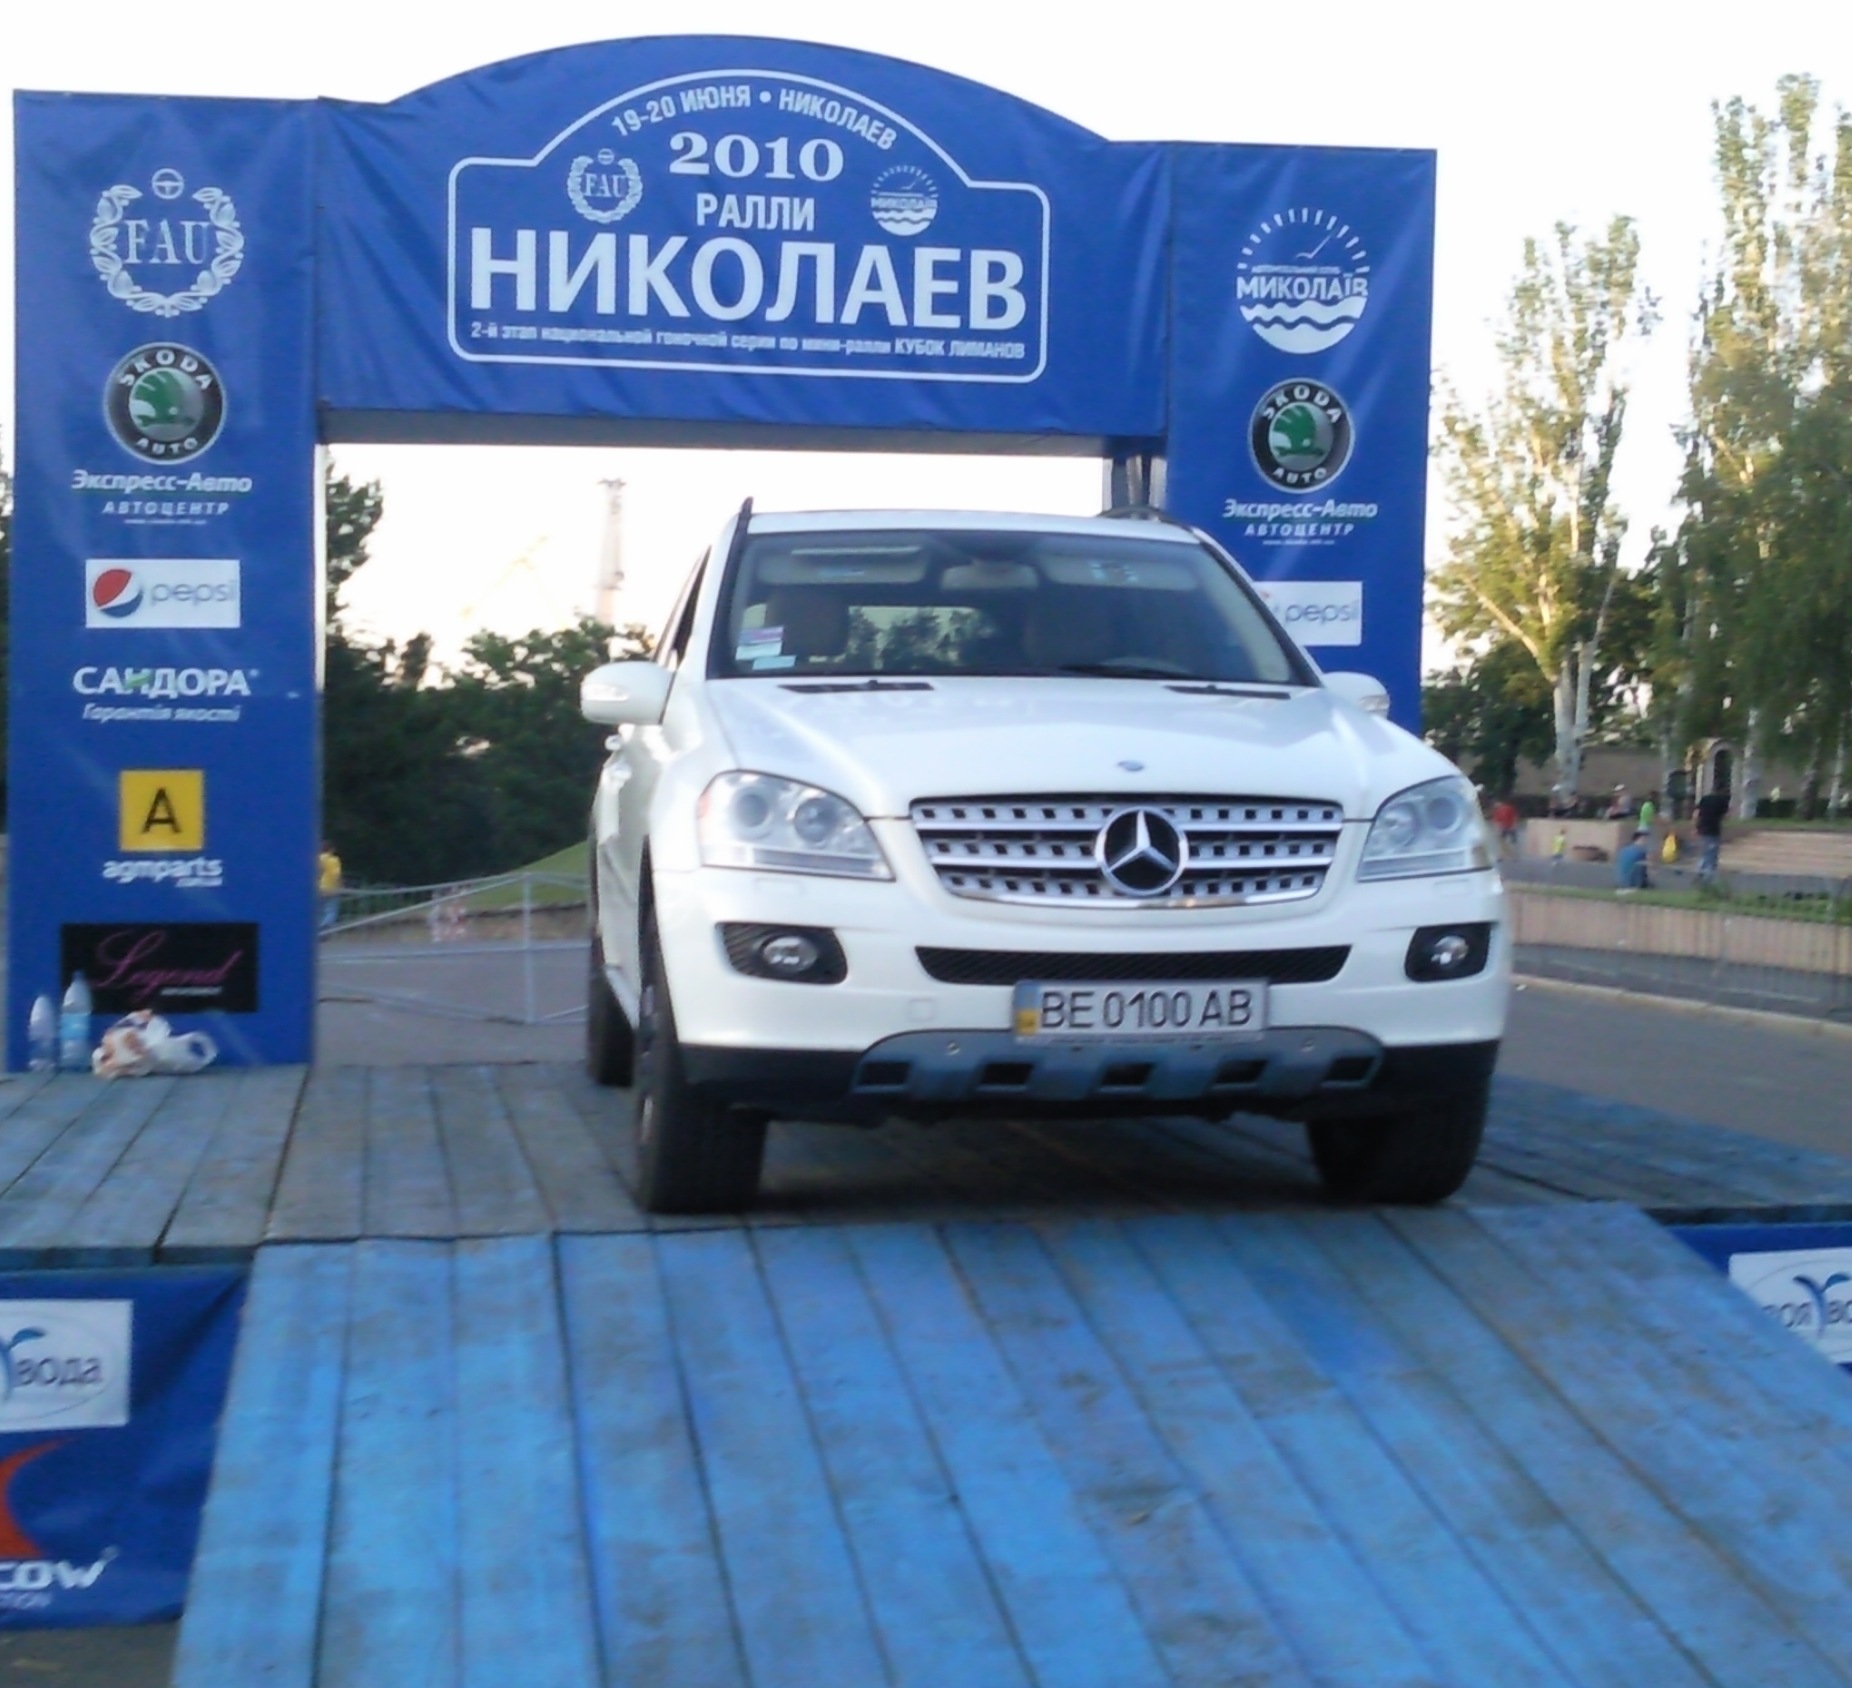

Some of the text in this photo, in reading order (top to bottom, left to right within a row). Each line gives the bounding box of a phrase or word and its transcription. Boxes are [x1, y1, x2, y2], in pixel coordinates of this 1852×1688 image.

[611, 85, 898, 150] 19-20 ИЮНЯ НИКОЛАЕВ
[669, 131, 845, 182] 2010
[583, 172, 628, 198] FAU
[696, 192, 815, 232] РАЛЛИ
[124, 219, 211, 264] FAU
[470, 227, 1027, 330] НИКОЛАЕВ
[1236, 272, 1369, 300] МИКОЛАЇВ
[894, 338, 945, 356] КУБОК
[136, 437, 199, 455] AUTO
[71, 468, 254, 495] Экспресс-Авто
[1272, 467, 1328, 484] AUTO
[102, 501, 230, 516] АВТОЦЕНТР
[1222, 498, 1380, 522] Экспресс-Авто
[1244, 523, 1355, 537] АВТОЦЕНТР
[151, 579, 237, 607] pepsi
[72, 666, 252, 699] САНДОРА
[142, 786, 181, 835] A
[1042, 989, 1252, 1028] BE 0100 AB
